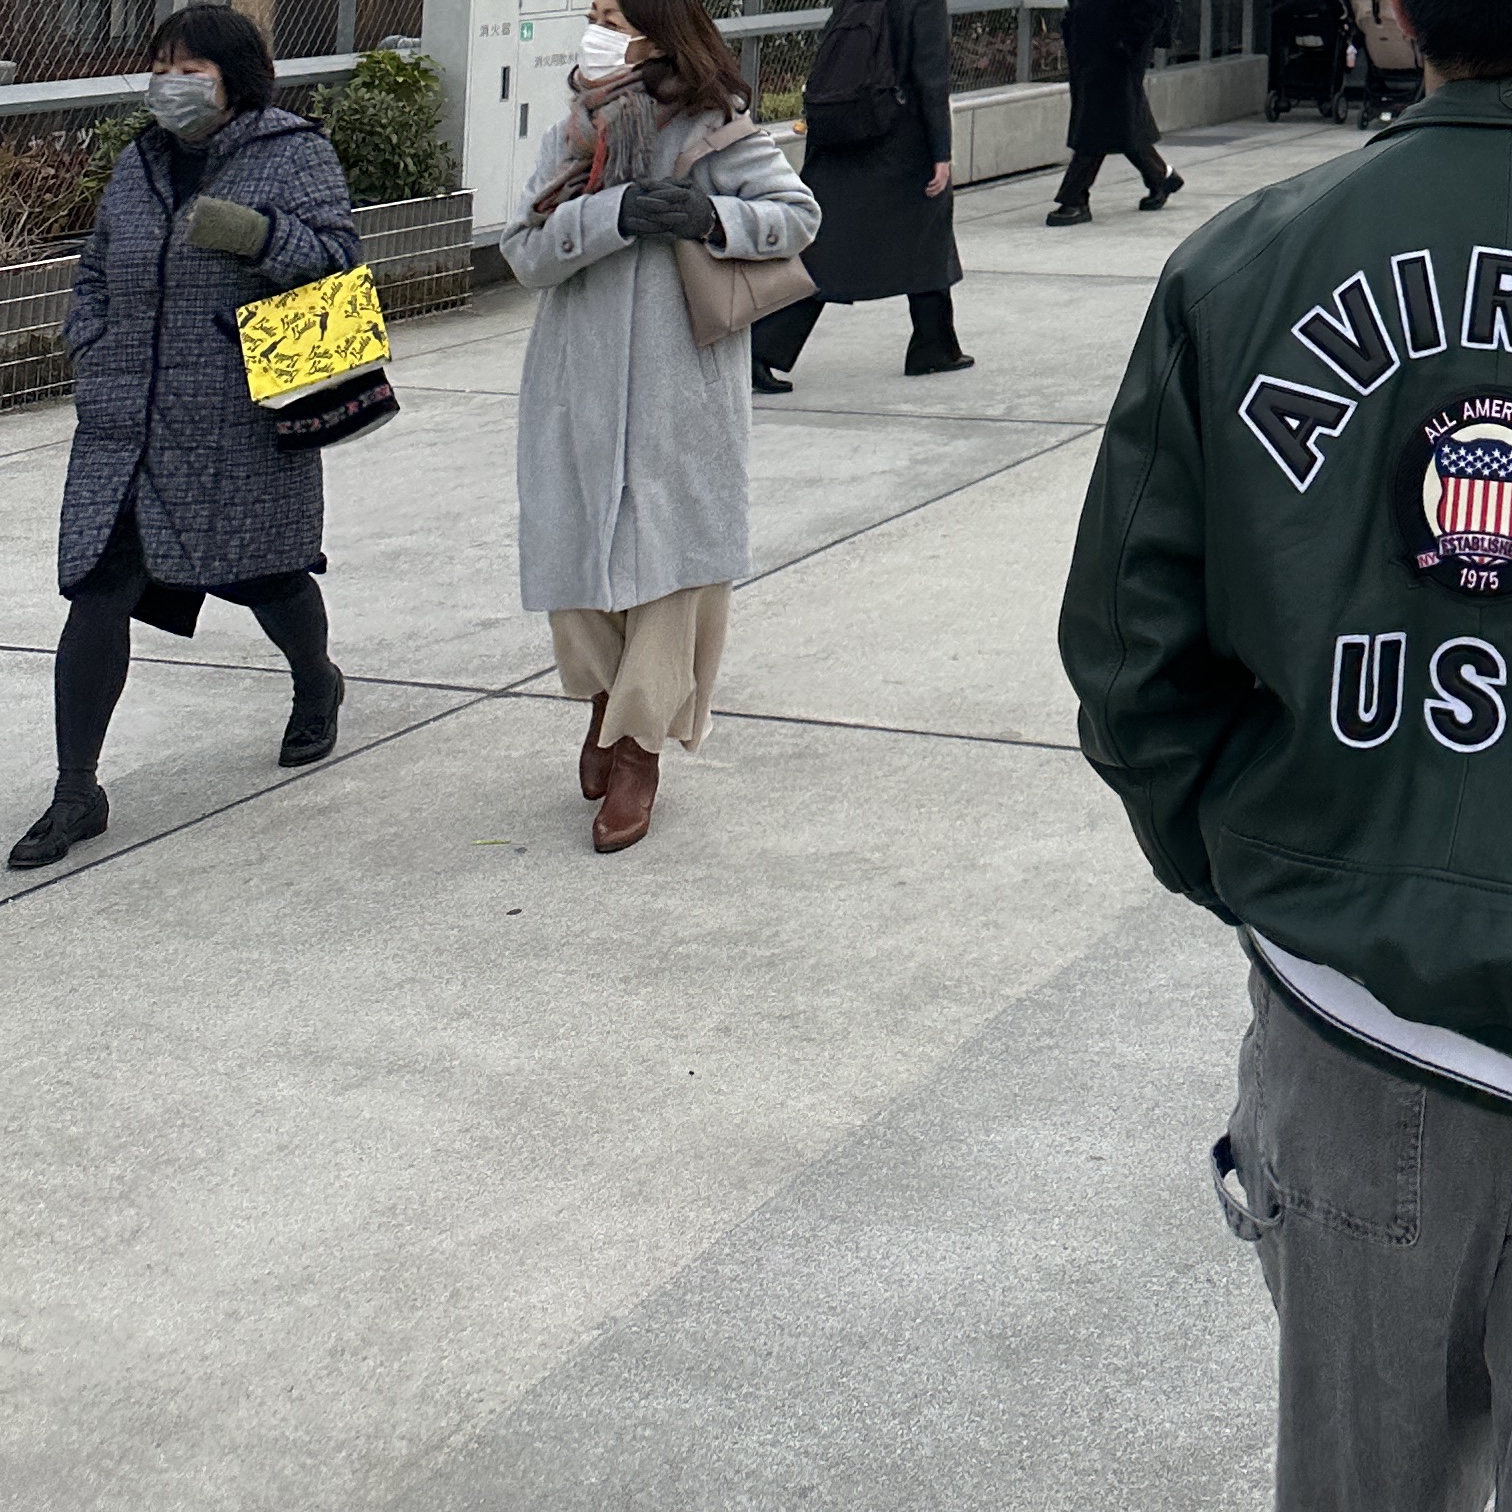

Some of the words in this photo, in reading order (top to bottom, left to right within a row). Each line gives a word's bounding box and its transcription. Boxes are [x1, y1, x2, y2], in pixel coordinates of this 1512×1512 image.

[1423, 411, 1457, 445] ALL
[1418, 552, 1437, 568] NY
[1460, 567, 1499, 590] 1975
